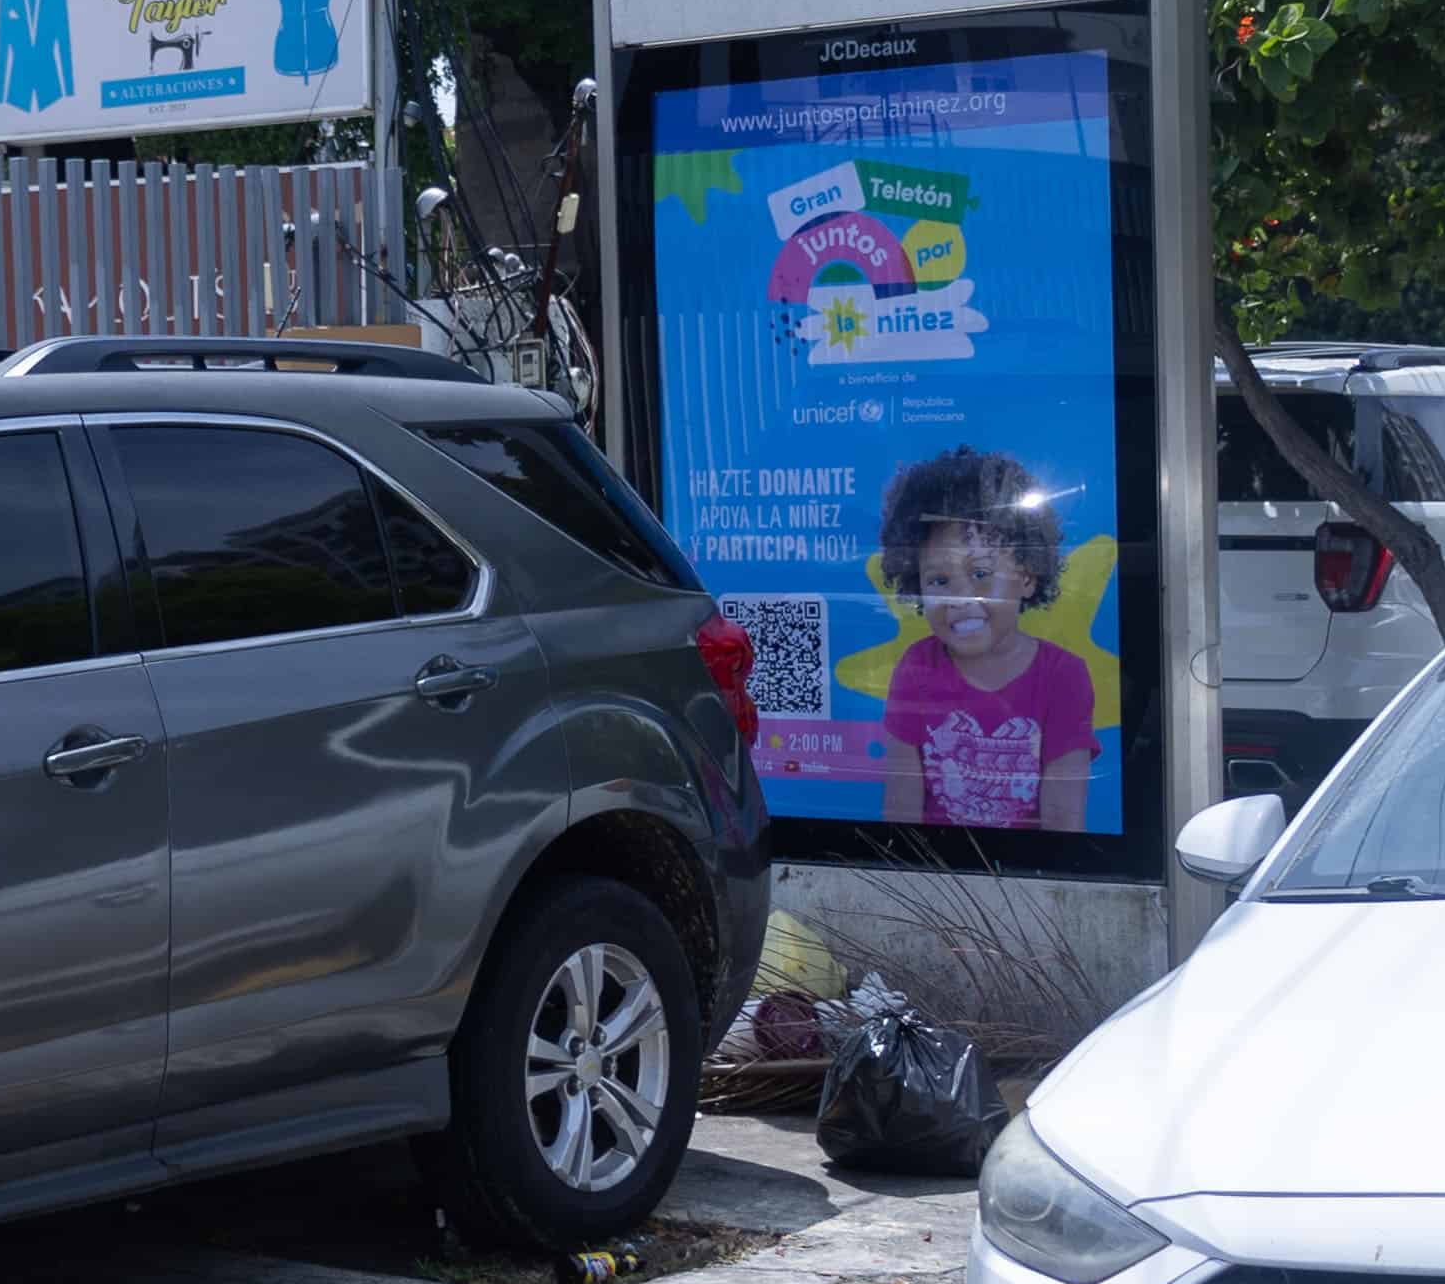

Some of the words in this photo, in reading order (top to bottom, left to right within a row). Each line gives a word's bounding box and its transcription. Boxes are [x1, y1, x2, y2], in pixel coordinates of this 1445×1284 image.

[819, 38, 916, 62] JCDecaux
[120, 77, 225, 101] ALTERACIONES
[720, 91, 1007, 134] www.juntosporlaninez.org
[789, 184, 843, 216] Gran
[869, 177, 953, 209] Teletón
[797, 223, 888, 267] juntos
[915, 239, 953, 268] por
[836, 313, 856, 333] la
[877, 306, 954, 333] niñez
[793, 400, 856, 425] unicef
[689, 469, 752, 497] ¡HAZTE
[758, 467, 856, 496] DONANTE
[700, 505, 750, 529] APOYA
[757, 505, 782, 529] LA
[789, 500, 842, 528] NIÑEZ
[689, 536, 702, 562] Y
[706, 535, 808, 562] PARTICIPA
[814, 534, 859, 562] HOY!
[789, 732, 819, 752] 2:00
[823, 733, 844, 753] PM
